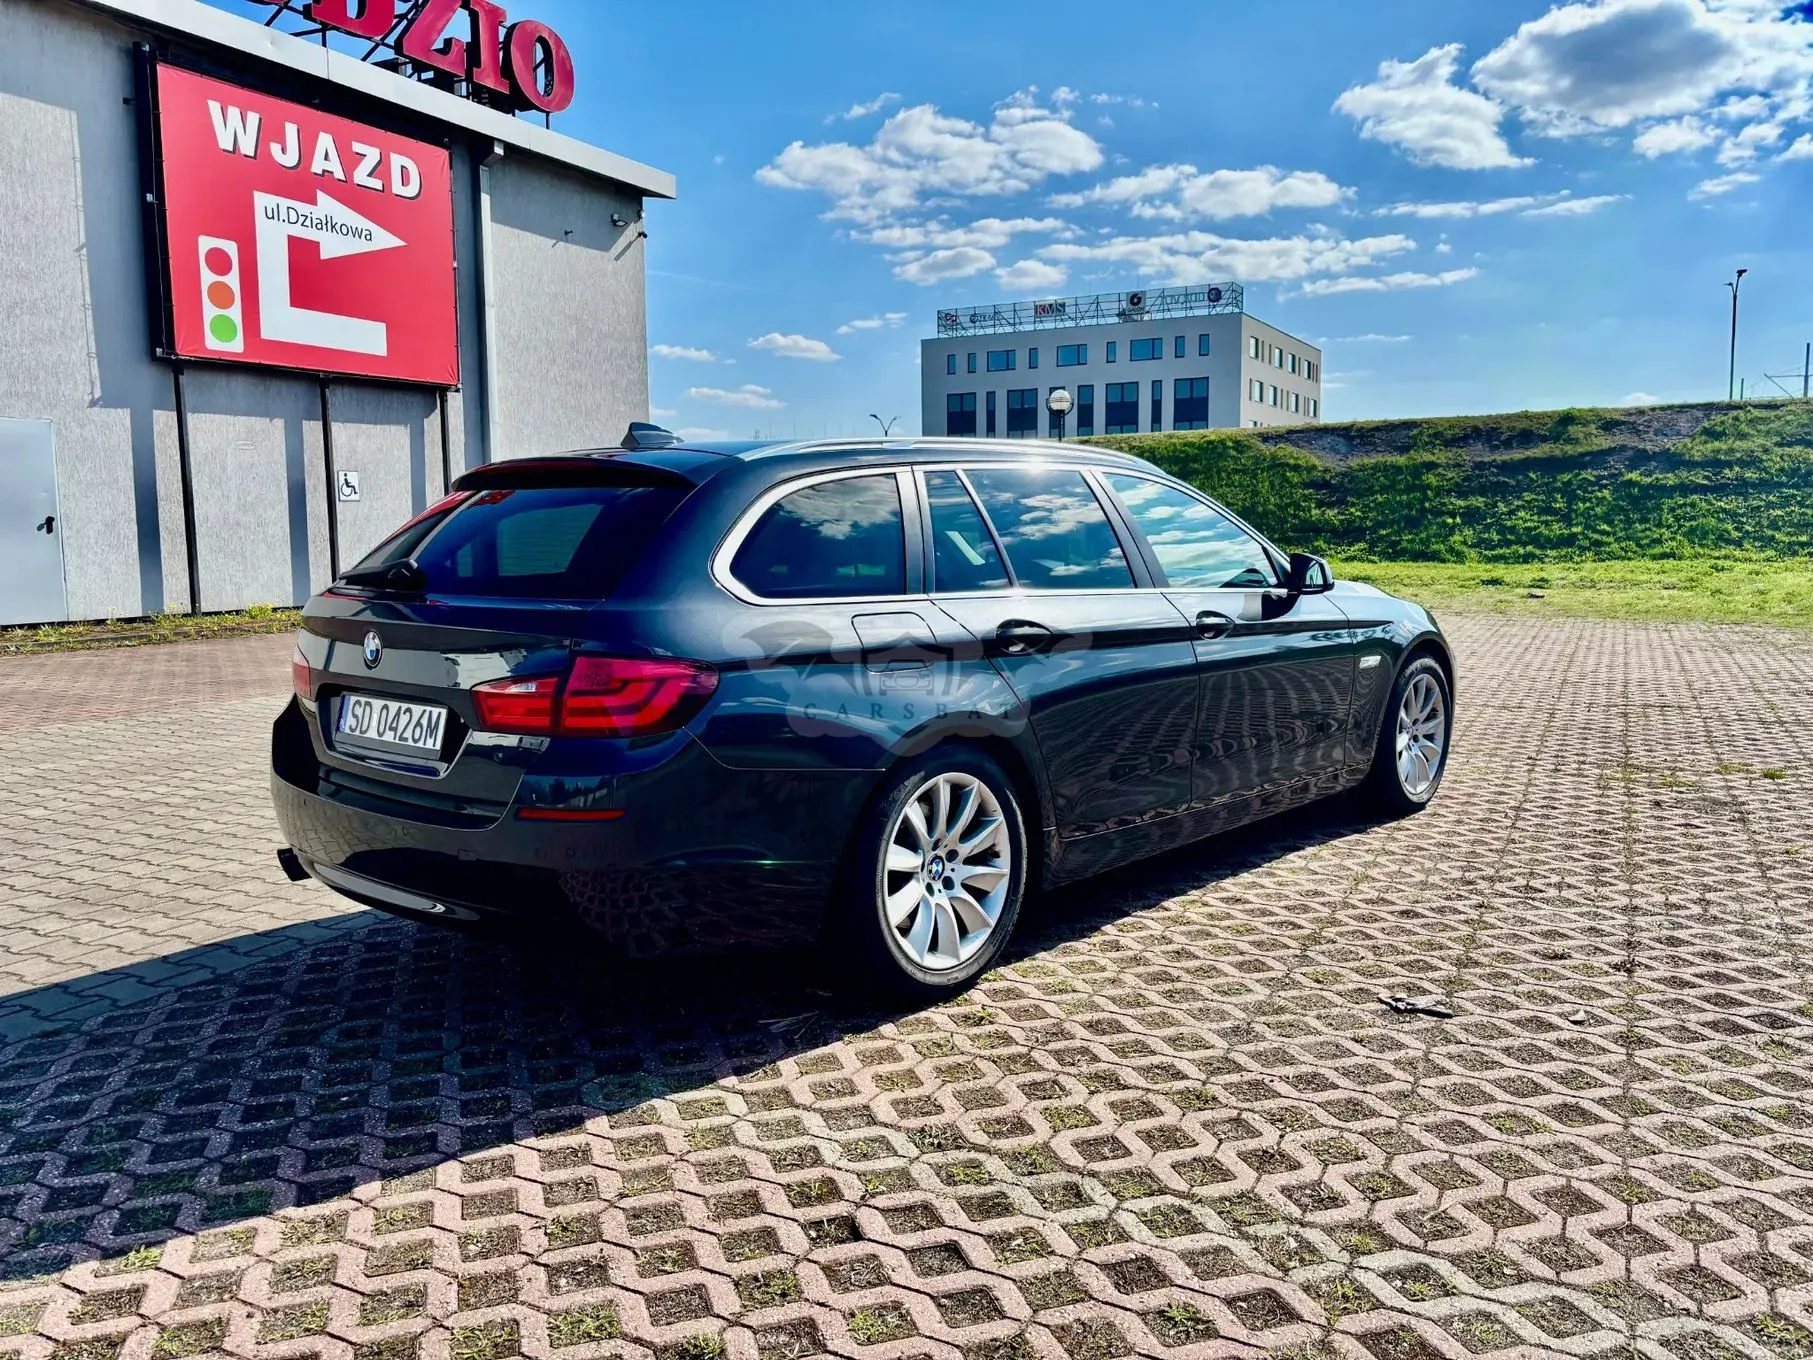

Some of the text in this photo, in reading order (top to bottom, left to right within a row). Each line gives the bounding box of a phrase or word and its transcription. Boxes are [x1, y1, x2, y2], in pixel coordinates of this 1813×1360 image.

[206, 98, 423, 200] WJAZD
[264, 203, 373, 242] ul.Działkowa
[1036, 303, 1065, 316] KMS
[349, 699, 442, 747] SD 0426M
